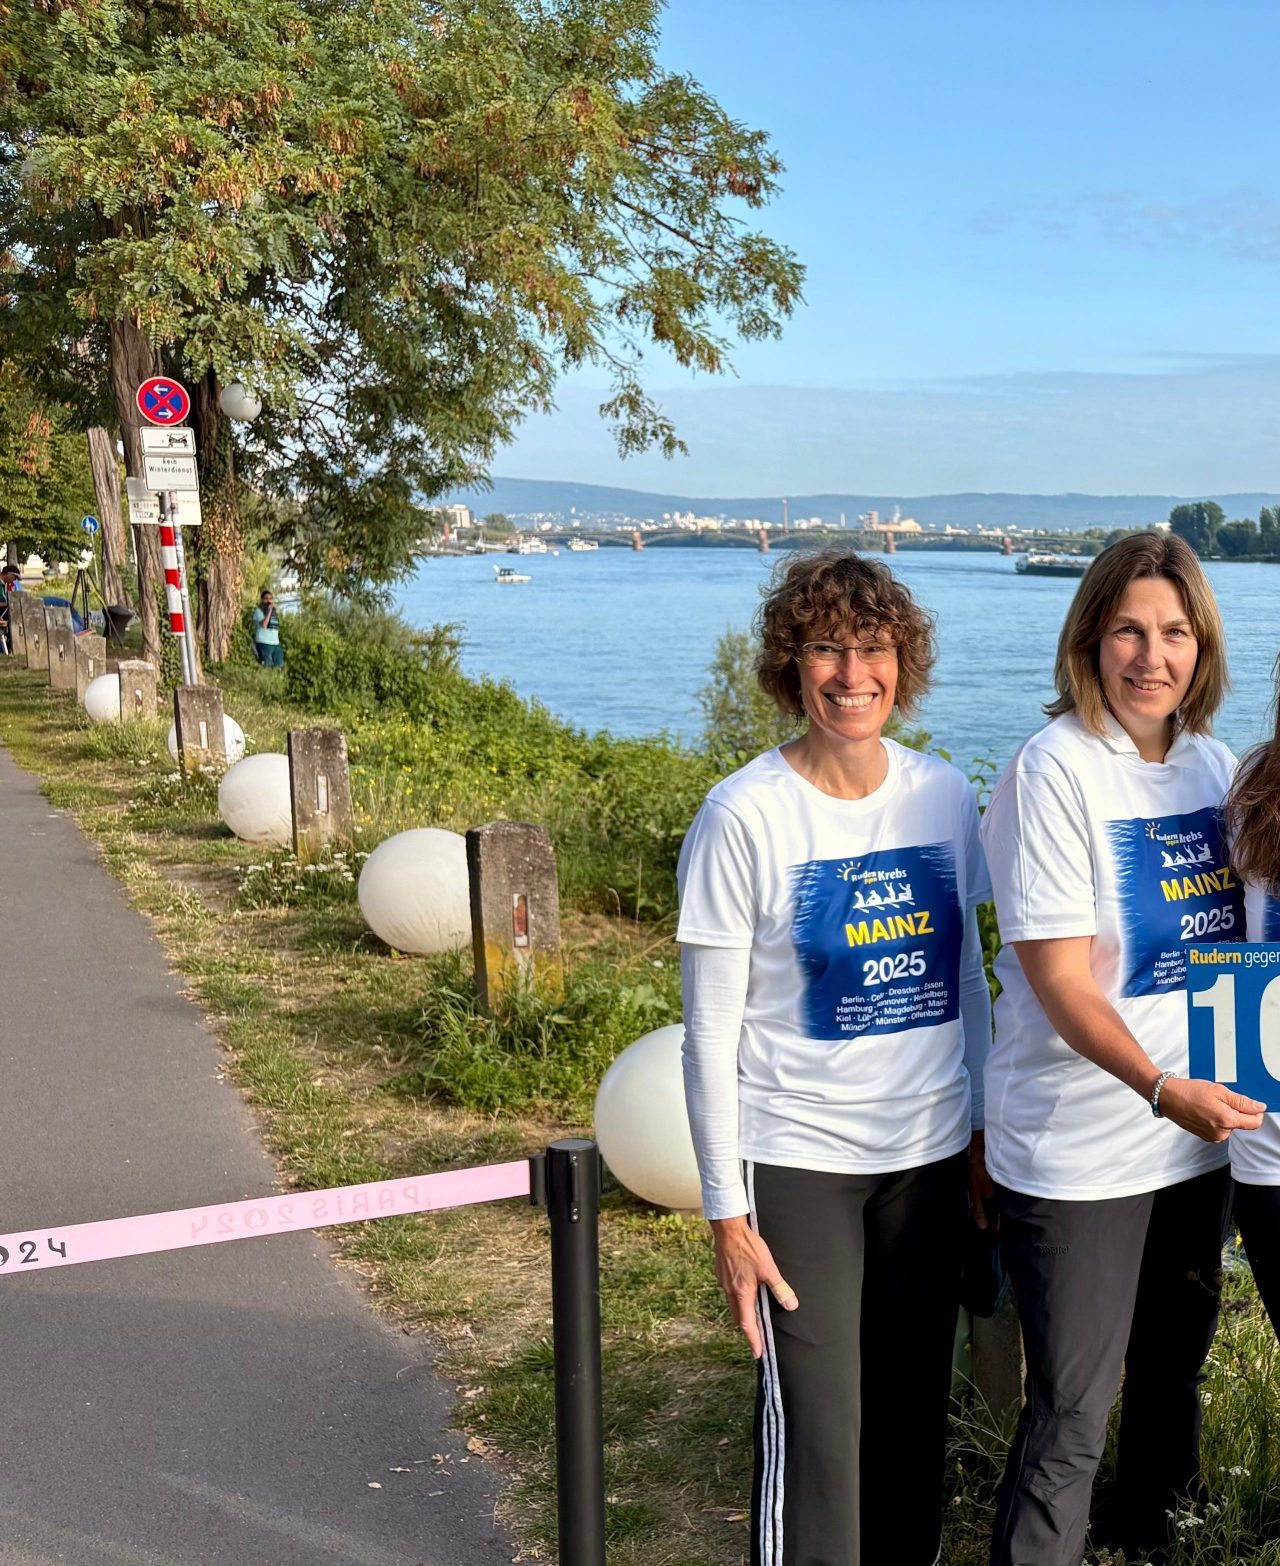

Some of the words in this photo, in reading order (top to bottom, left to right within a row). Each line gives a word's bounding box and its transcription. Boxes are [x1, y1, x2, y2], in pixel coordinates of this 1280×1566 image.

[877, 868, 907, 881] Krebs
[1160, 867, 1236, 902] MAINZ
[845, 911, 934, 947] MAINZ
[1180, 904, 1235, 941] 2025
[1160, 950, 1180, 959] Berlin
[1189, 948, 1242, 964] Rudern
[863, 951, 927, 987] 2025
[841, 996, 865, 1005] Berlin
[888, 985, 920, 996] Dresden
[836, 1005, 873, 1015] Hamburg
[884, 1003, 923, 1015] Magdeburg
[875, 1015, 907, 1025] Münster
